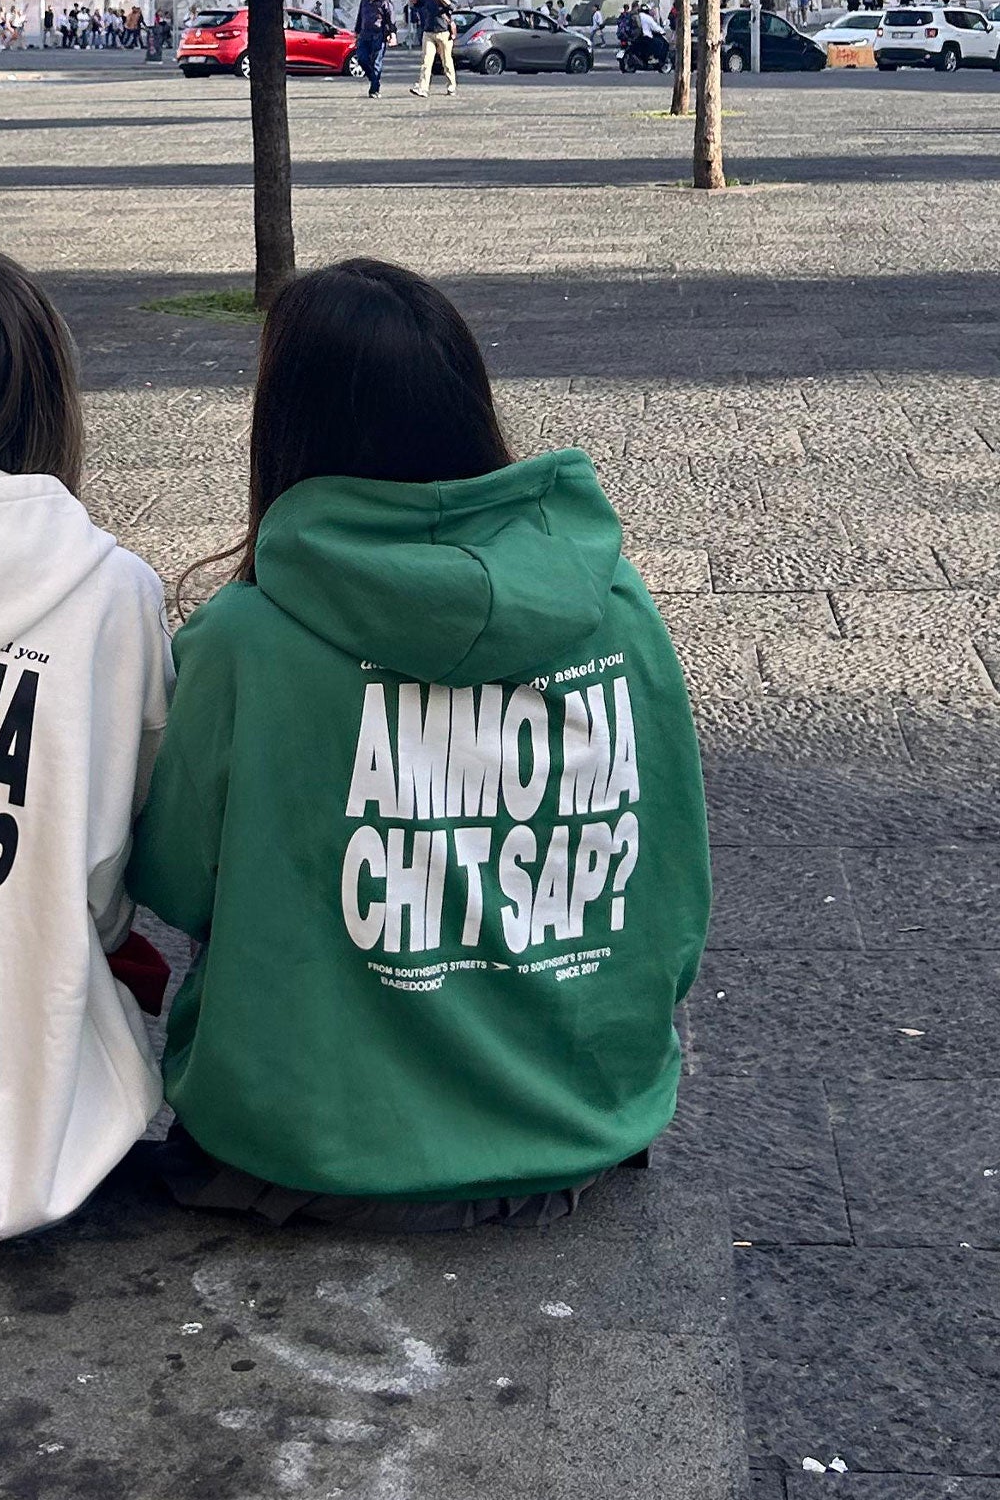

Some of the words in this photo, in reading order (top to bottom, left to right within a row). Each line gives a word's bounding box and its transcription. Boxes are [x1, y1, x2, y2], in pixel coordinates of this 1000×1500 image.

[14, 647, 50, 664] you
[554, 659, 596, 682] asked
[598, 652, 624, 673] you
[345, 683, 550, 821] AMMO
[558, 676, 640, 816] MA
[367, 962, 393, 975] FROM
[395, 962, 448, 978] SOUTHSIDE'S
[449, 960, 488, 971] STREETS
[517, 964, 529, 974] TO
[530, 953, 576, 972] SOUTHSIDE'S
[577, 947, 611, 961] STREETS
[555, 966, 580, 981] SINCE
[580, 962, 600, 975] 2017
